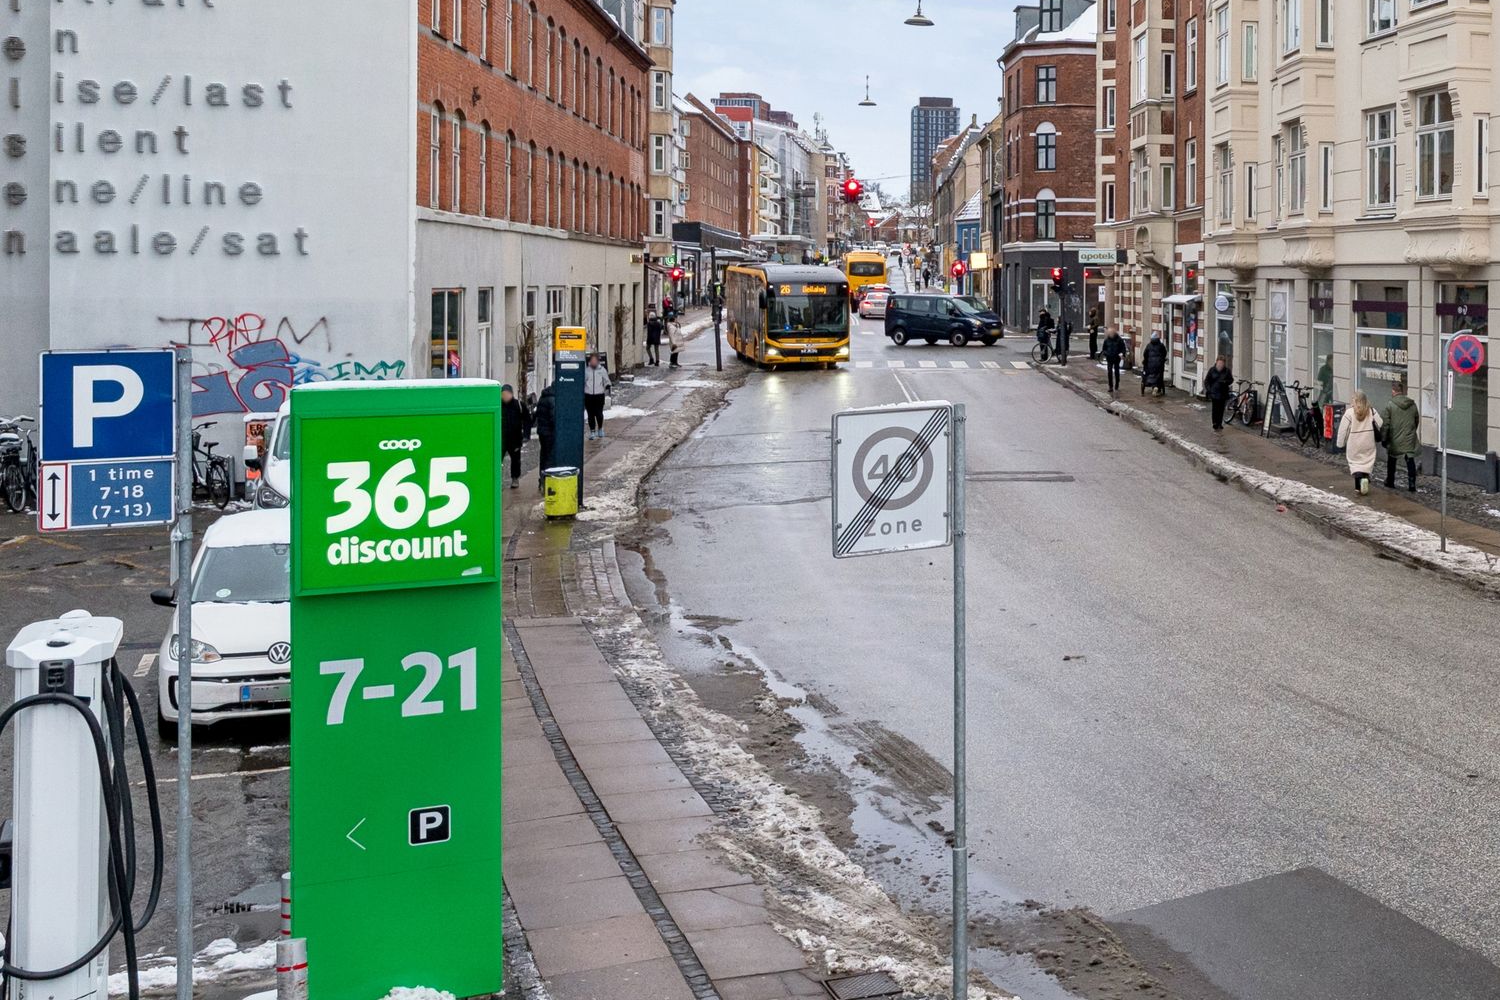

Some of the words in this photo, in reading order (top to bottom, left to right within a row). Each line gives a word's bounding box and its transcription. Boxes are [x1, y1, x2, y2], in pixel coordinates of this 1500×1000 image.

[1080, 253, 1115, 262] apotek
[780, 285, 791, 294] 26
[73, 365, 145, 448] P
[378, 438, 422, 452] coop
[89, 469, 96, 482] 1
[109, 468, 154, 481] time
[100, 485, 145, 500] 7-18
[326, 456, 471, 534] 365
[92, 502, 152, 520] (7-13)
[864, 519, 923, 538] Zone
[327, 530, 468, 565] discount
[319, 646, 478, 726] 7-21
[420, 811, 443, 839] P
